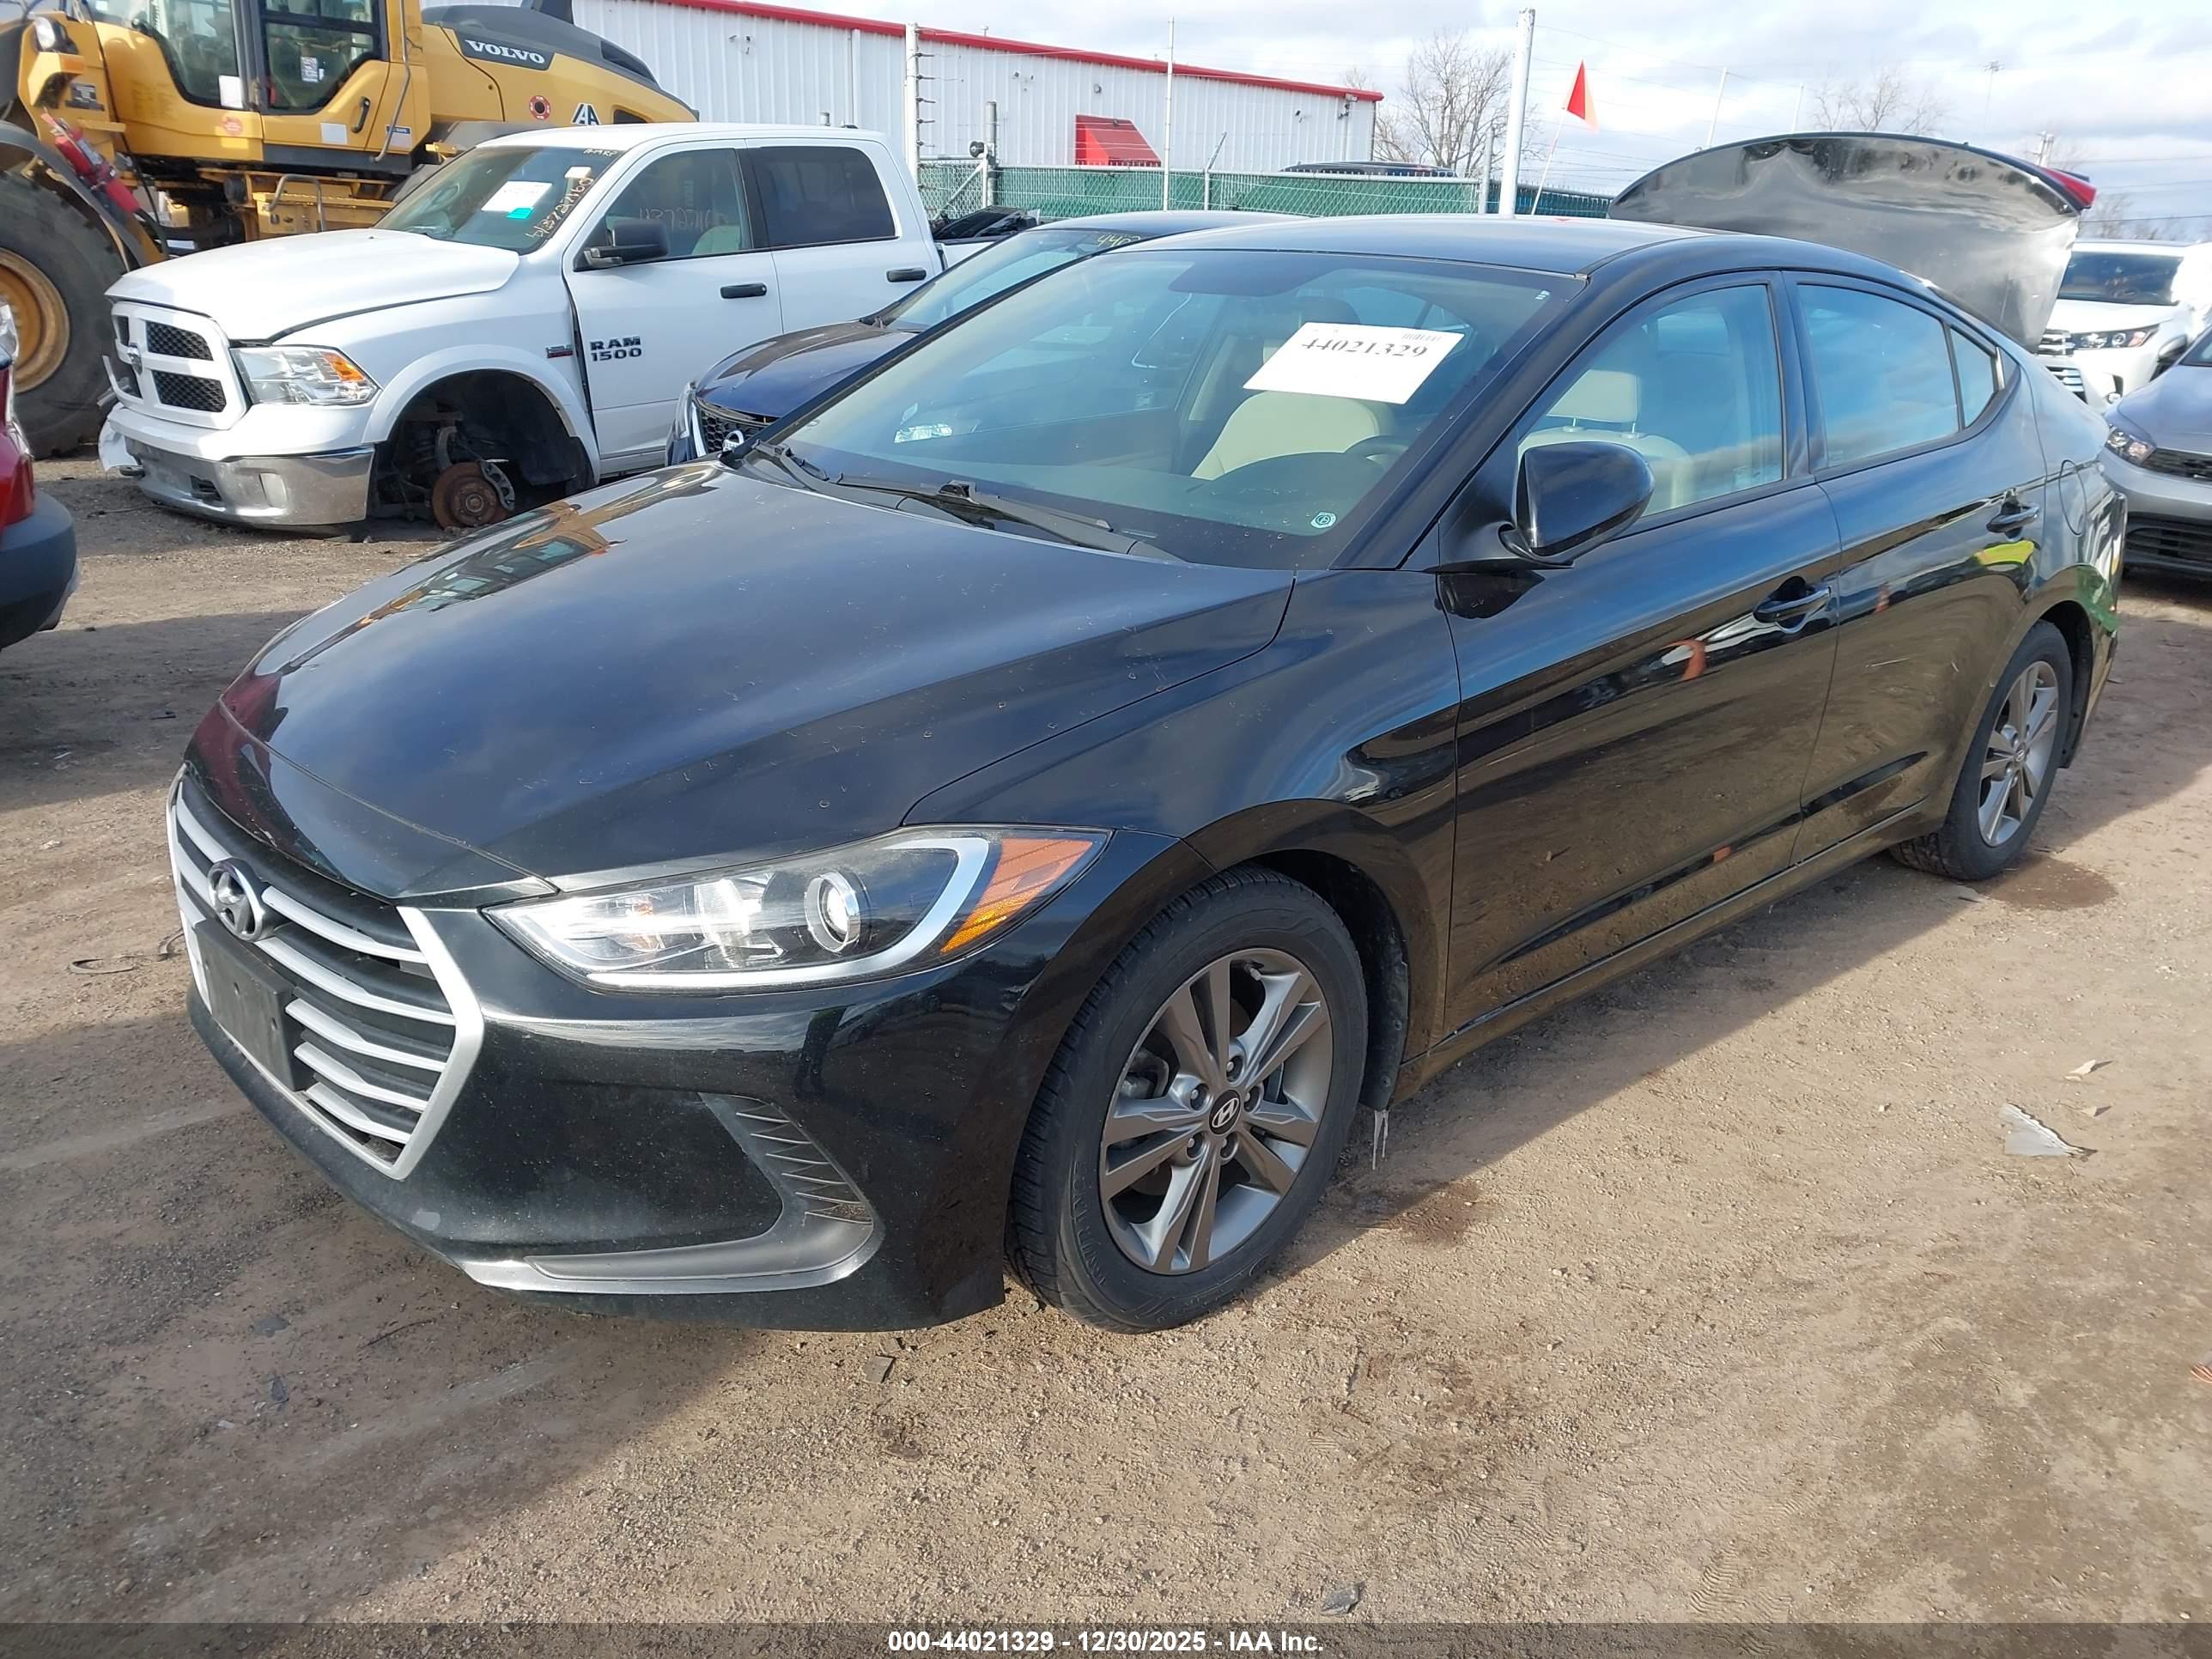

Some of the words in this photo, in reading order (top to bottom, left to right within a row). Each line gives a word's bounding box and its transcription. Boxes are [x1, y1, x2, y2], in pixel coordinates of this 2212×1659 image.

[465, 40, 545, 64] VOLVO
[590, 337, 641, 350] RAM
[1302, 338, 1429, 357] 44021329
[591, 348, 642, 362] 1500
